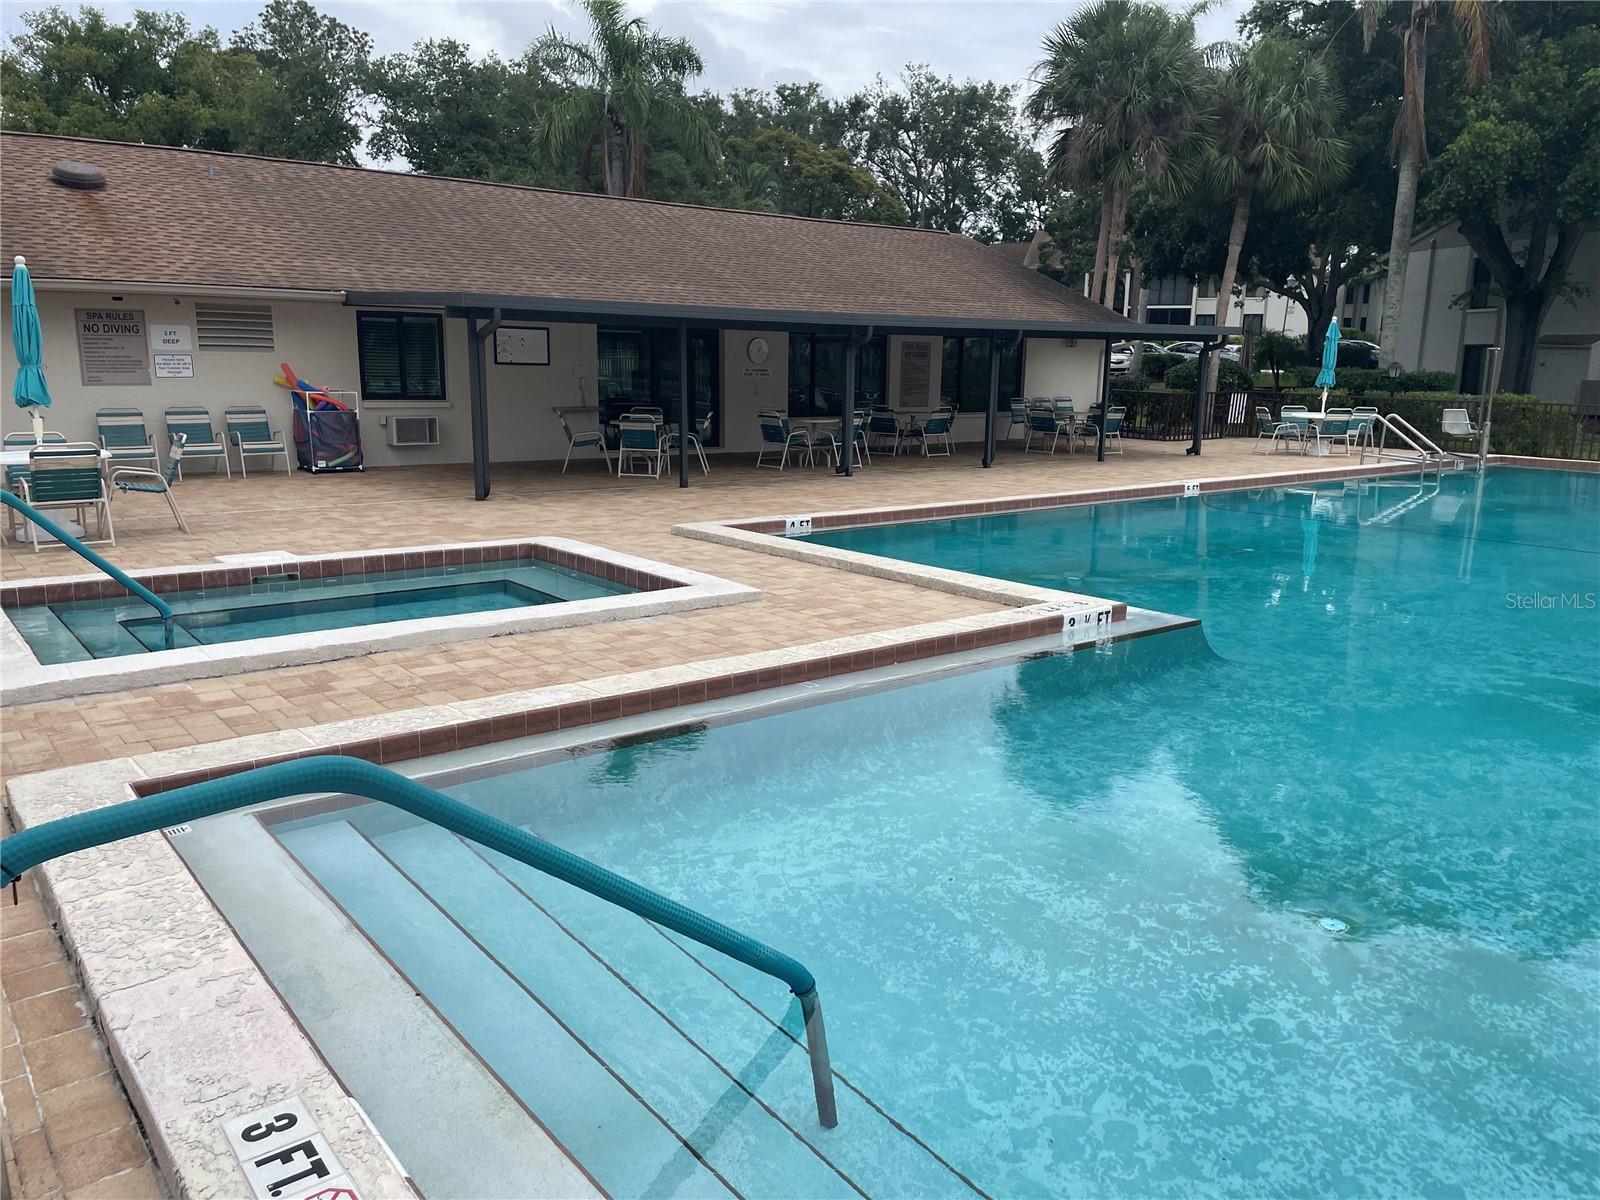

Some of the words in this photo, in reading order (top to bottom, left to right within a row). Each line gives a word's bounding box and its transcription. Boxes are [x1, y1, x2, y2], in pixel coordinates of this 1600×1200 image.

[86, 311, 103, 320] SPA
[106, 312, 134, 321] RULES
[83, 323, 100, 334] NO
[103, 323, 140, 335] DIVING
[1097, 610, 1111, 625] FT
[241, 1112, 298, 1142] 3
